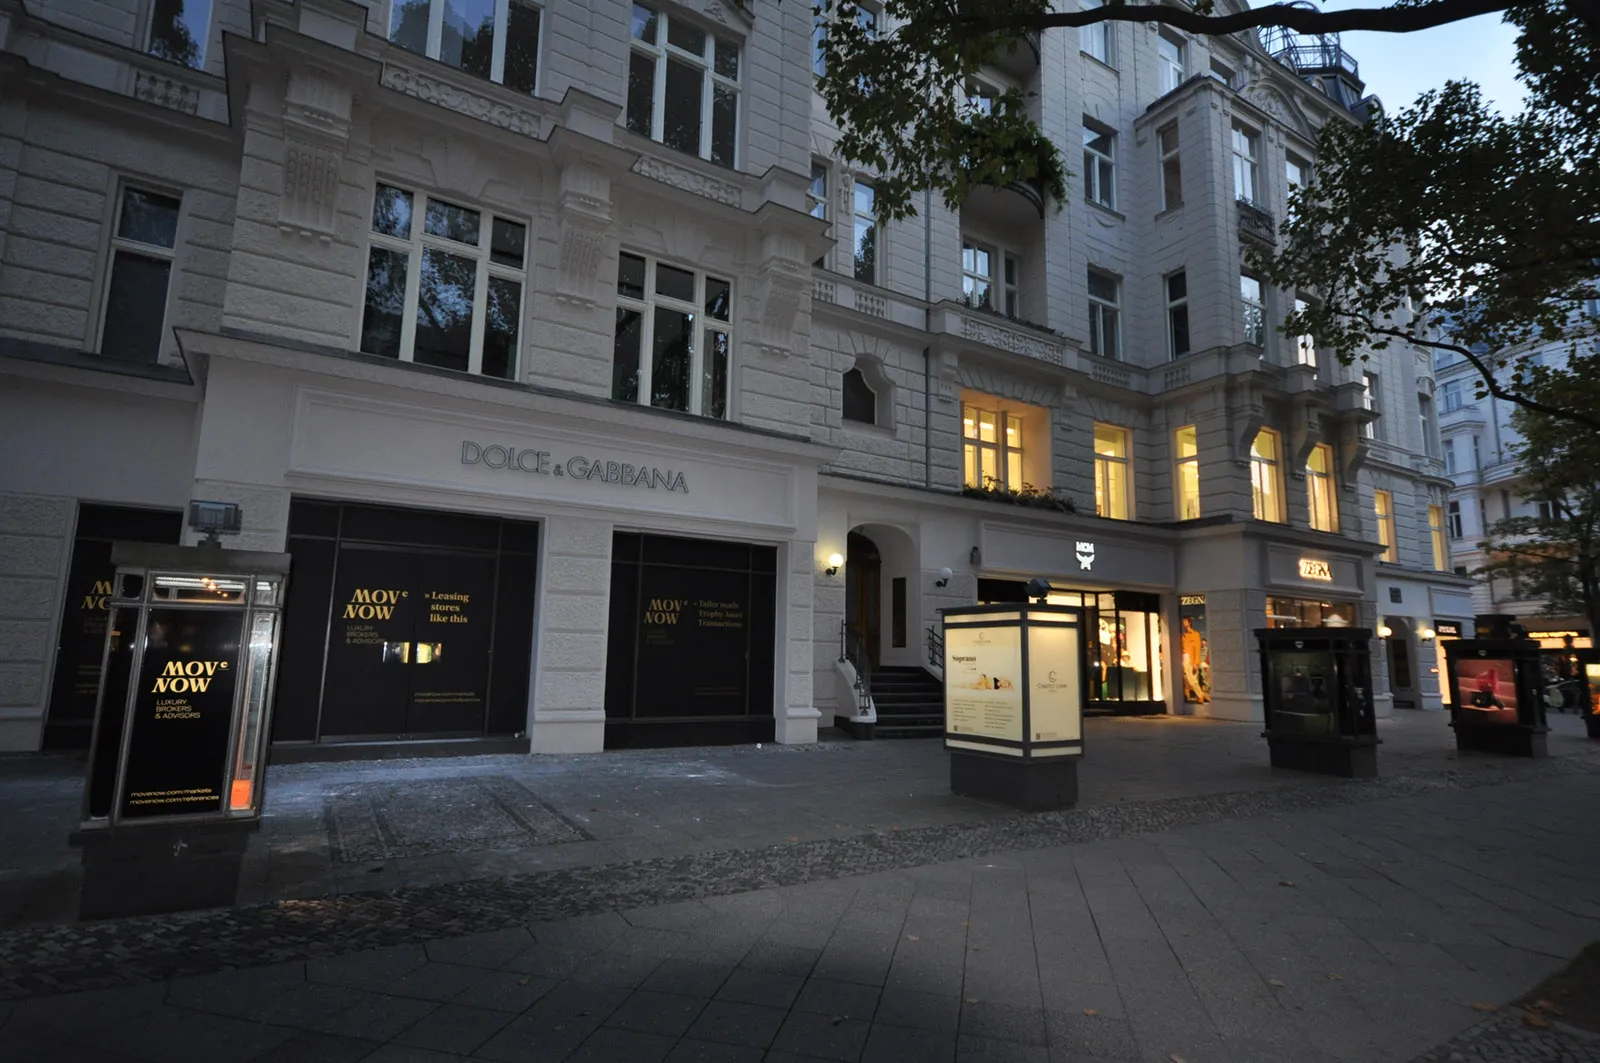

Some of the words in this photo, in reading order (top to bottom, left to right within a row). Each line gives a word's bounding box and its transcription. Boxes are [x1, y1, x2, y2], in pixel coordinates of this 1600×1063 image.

[461, 440, 550, 475] DOLCE
[553, 464, 564, 477] &
[566, 456, 690, 493] GABBANA
[432, 591, 470, 603] Leasing
[342, 603, 395, 620] NOW
[430, 603, 461, 612] stores
[429, 613, 448, 623] like
[449, 614, 468, 624] this
[643, 611, 679, 625] NOW
[151, 677, 213, 693] NOW
[155, 705, 192, 713] BROKERS
[154, 712, 161, 720] &
